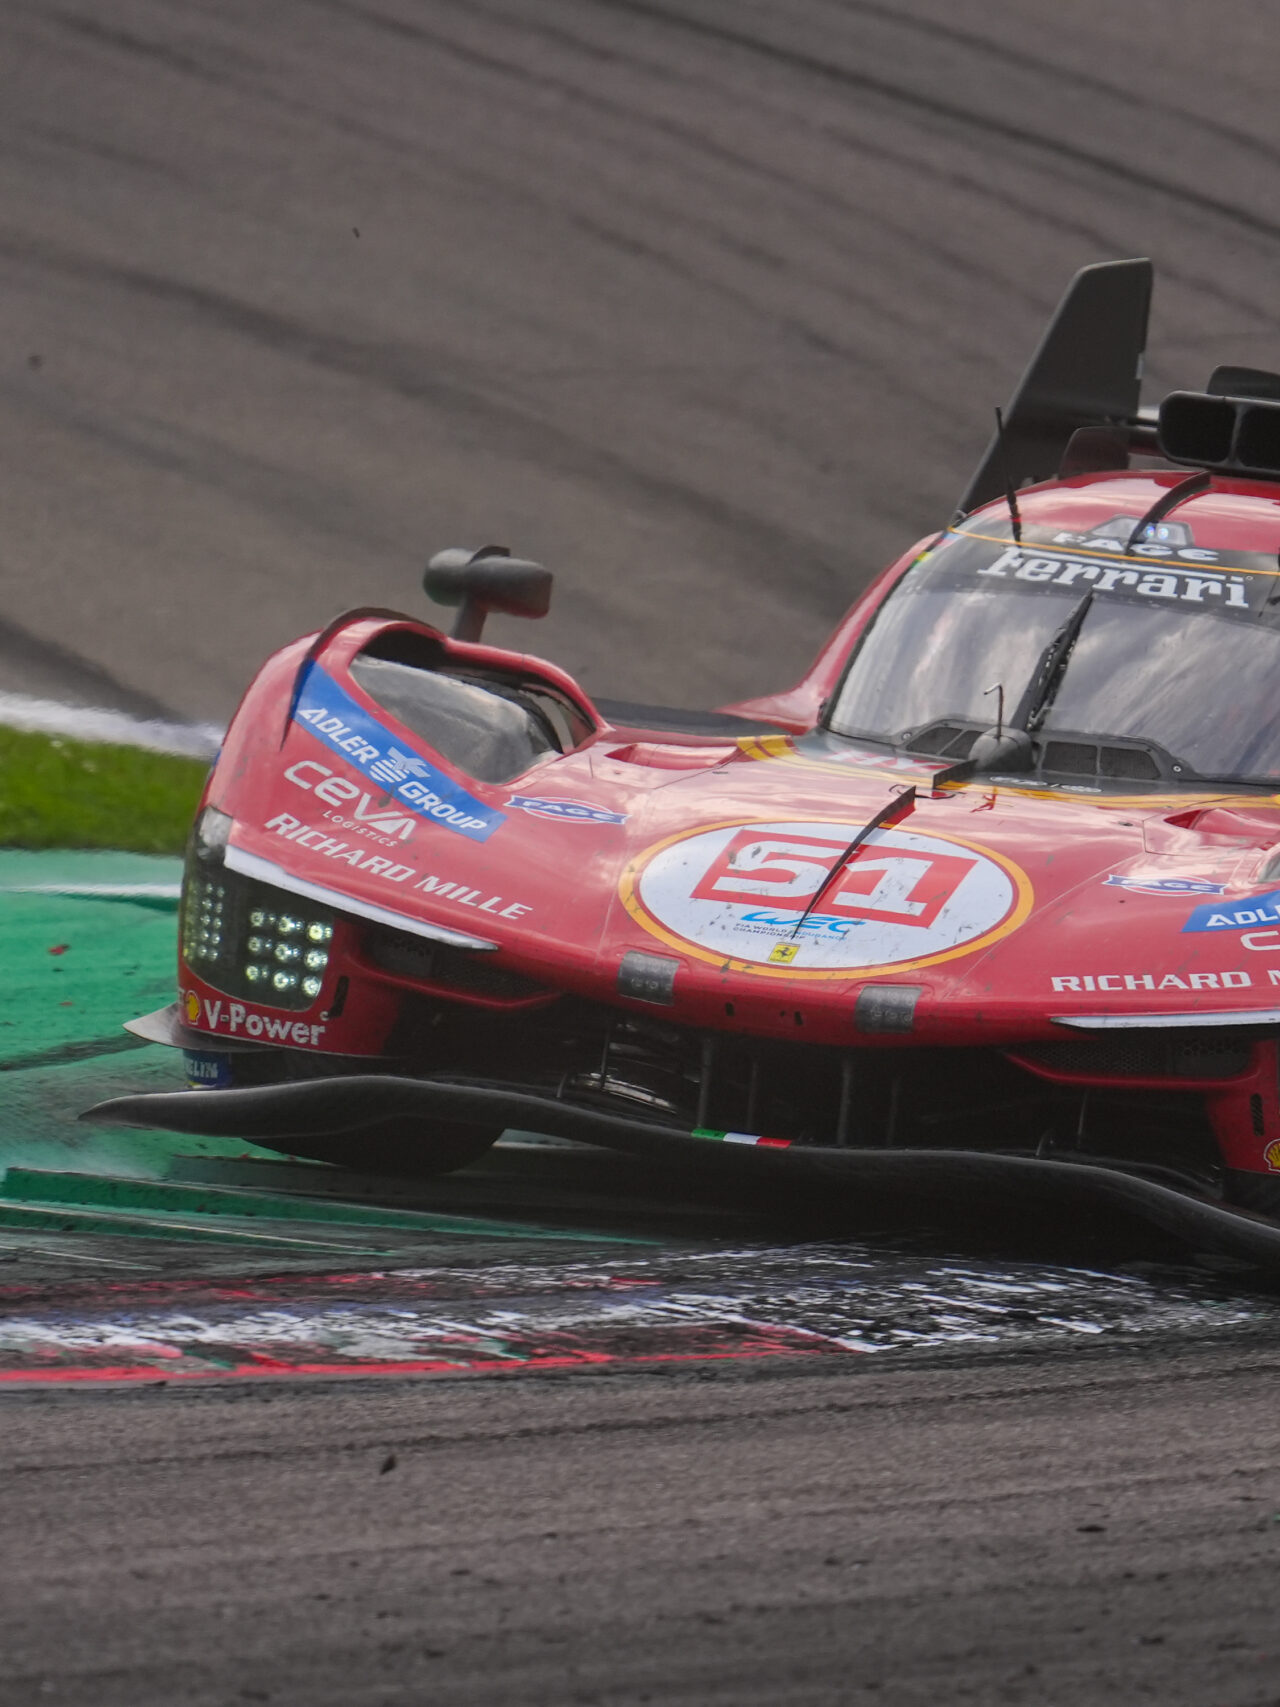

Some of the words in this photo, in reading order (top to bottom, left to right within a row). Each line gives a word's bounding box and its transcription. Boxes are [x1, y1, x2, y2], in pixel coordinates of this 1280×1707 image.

[977, 546, 1250, 609] Ferrari
[297, 706, 381, 764] ADLER
[398, 780, 488, 833] GROUP
[321, 808, 399, 848] LOGISTICS
[264, 812, 417, 884] RICHARD
[413, 874, 534, 920] MILLE
[710, 838, 934, 917] 51
[1050, 970, 1253, 993] RICHARD
[203, 998, 327, 1046] V-Power
